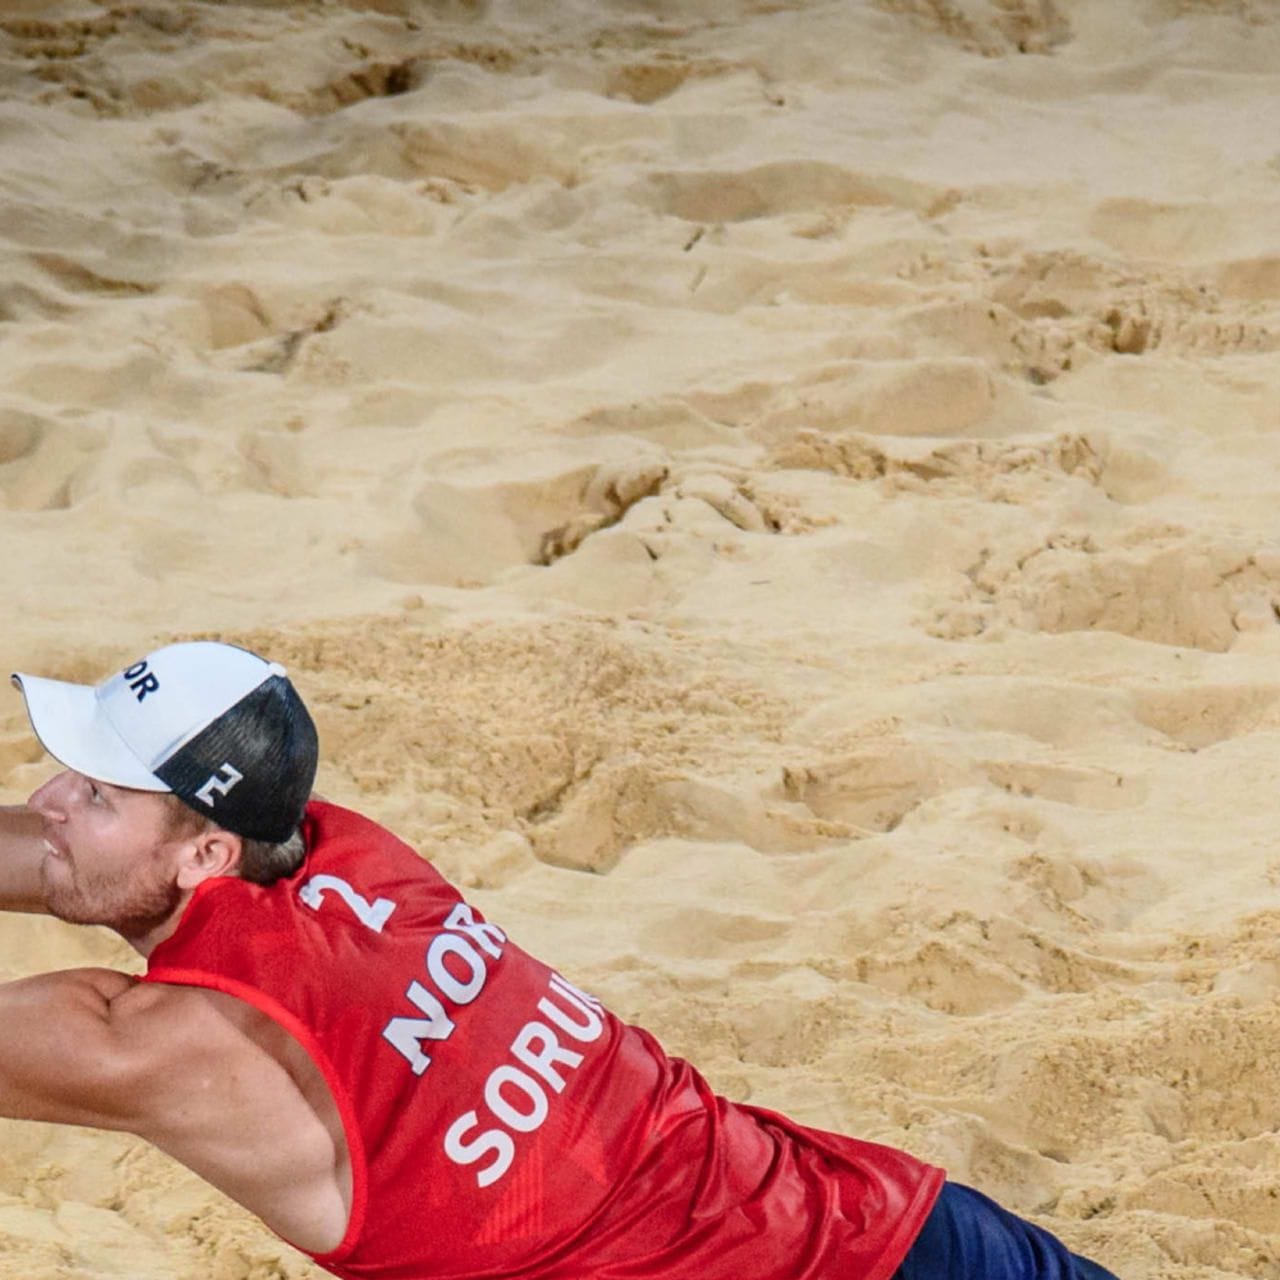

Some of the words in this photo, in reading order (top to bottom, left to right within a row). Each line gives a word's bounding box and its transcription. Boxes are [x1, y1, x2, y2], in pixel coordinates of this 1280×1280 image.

[123, 661, 160, 702] OR
[298, 874, 397, 933] 2
[381, 902, 508, 1076] NOR
